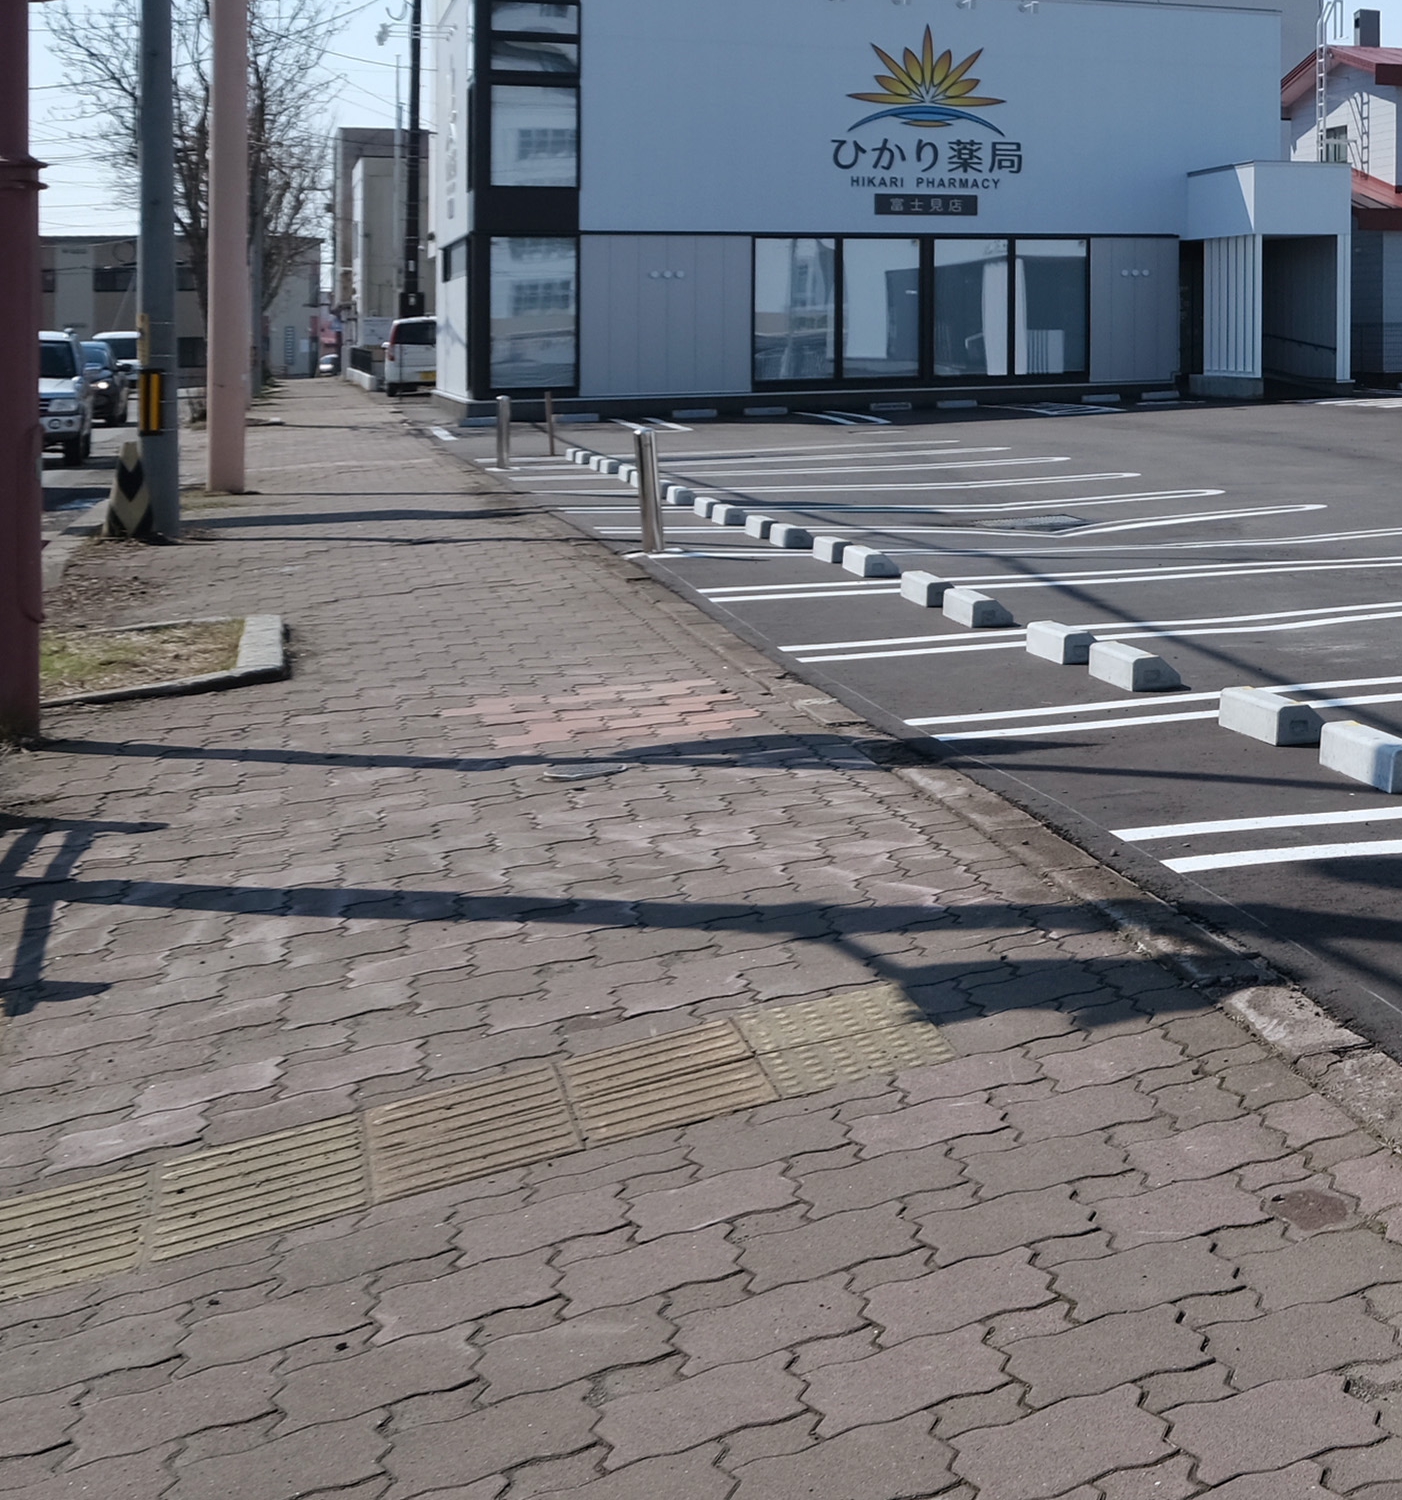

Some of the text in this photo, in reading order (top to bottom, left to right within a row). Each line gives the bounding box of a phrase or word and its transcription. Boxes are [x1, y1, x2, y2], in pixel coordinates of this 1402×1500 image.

[831, 138, 1023, 174] ひかり薬局
[851, 176, 1000, 190] HIKARI PHARMACY
[890, 198, 963, 213] 富士見店
